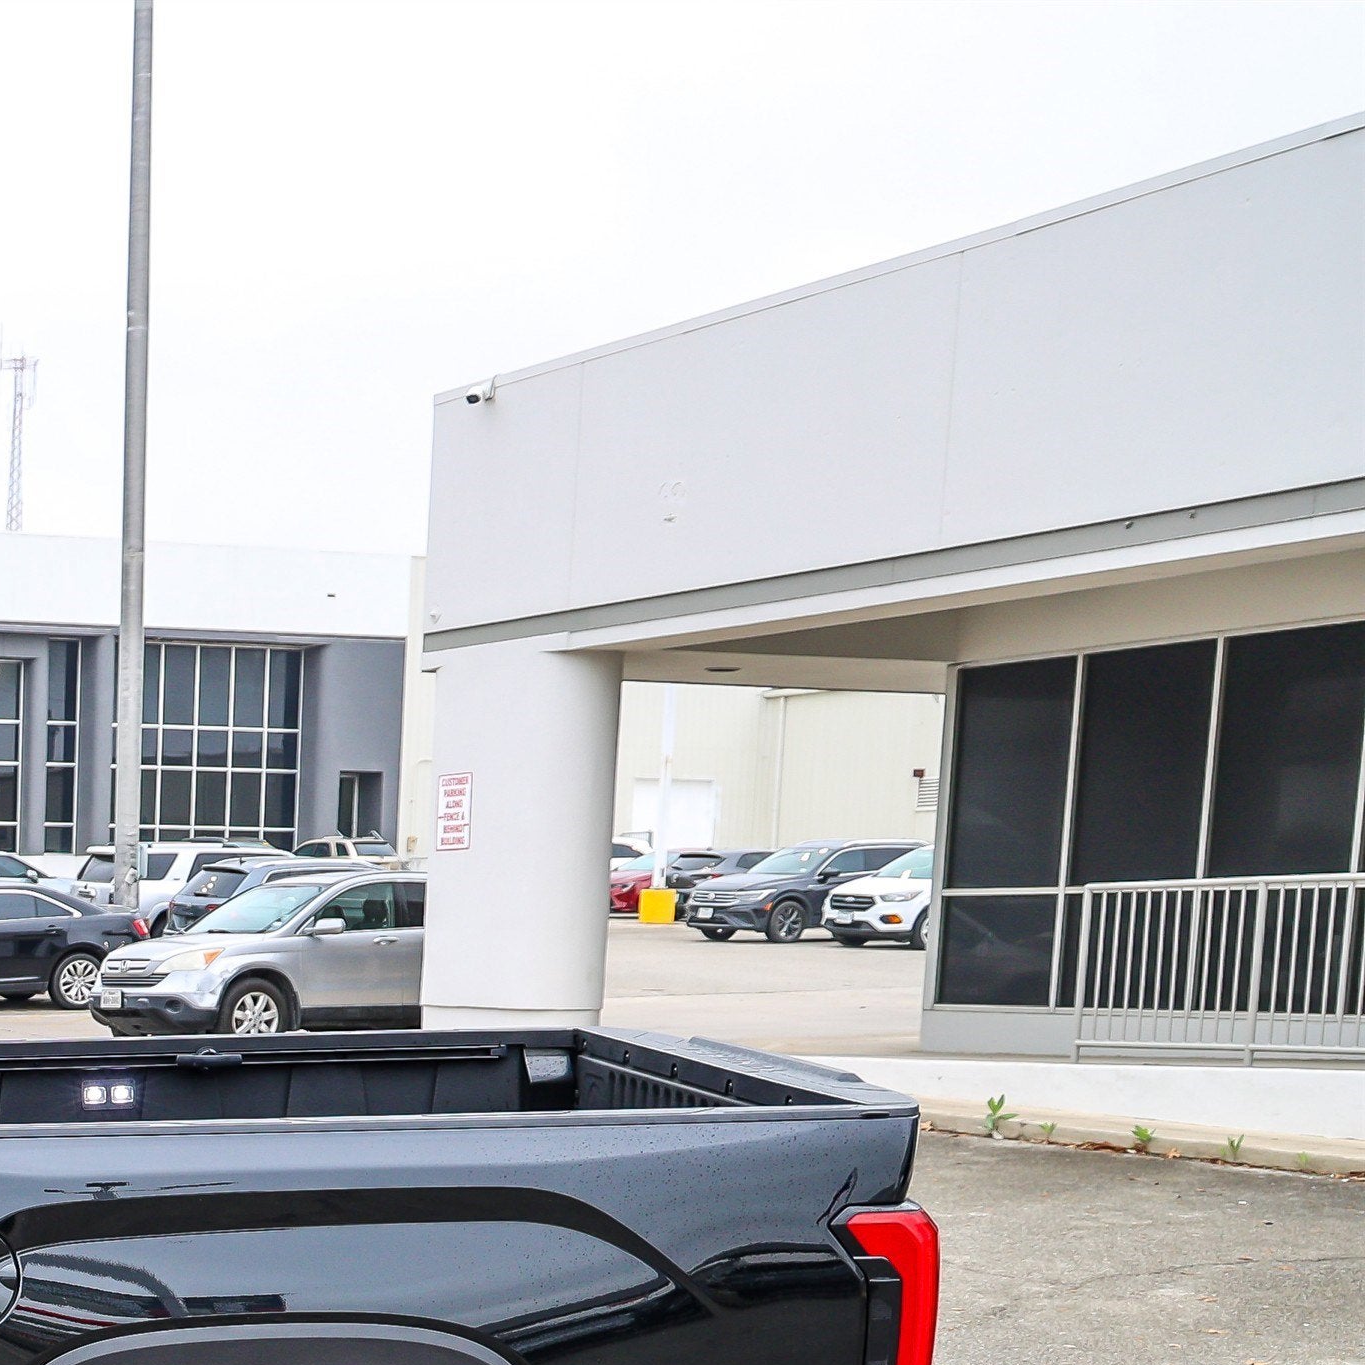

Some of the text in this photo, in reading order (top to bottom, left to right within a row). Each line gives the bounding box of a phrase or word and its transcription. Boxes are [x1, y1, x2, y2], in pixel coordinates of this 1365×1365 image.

[444, 788, 466, 797] PARKING
[446, 800, 463, 808] ALONG
[441, 837, 465, 845] BUILDING
